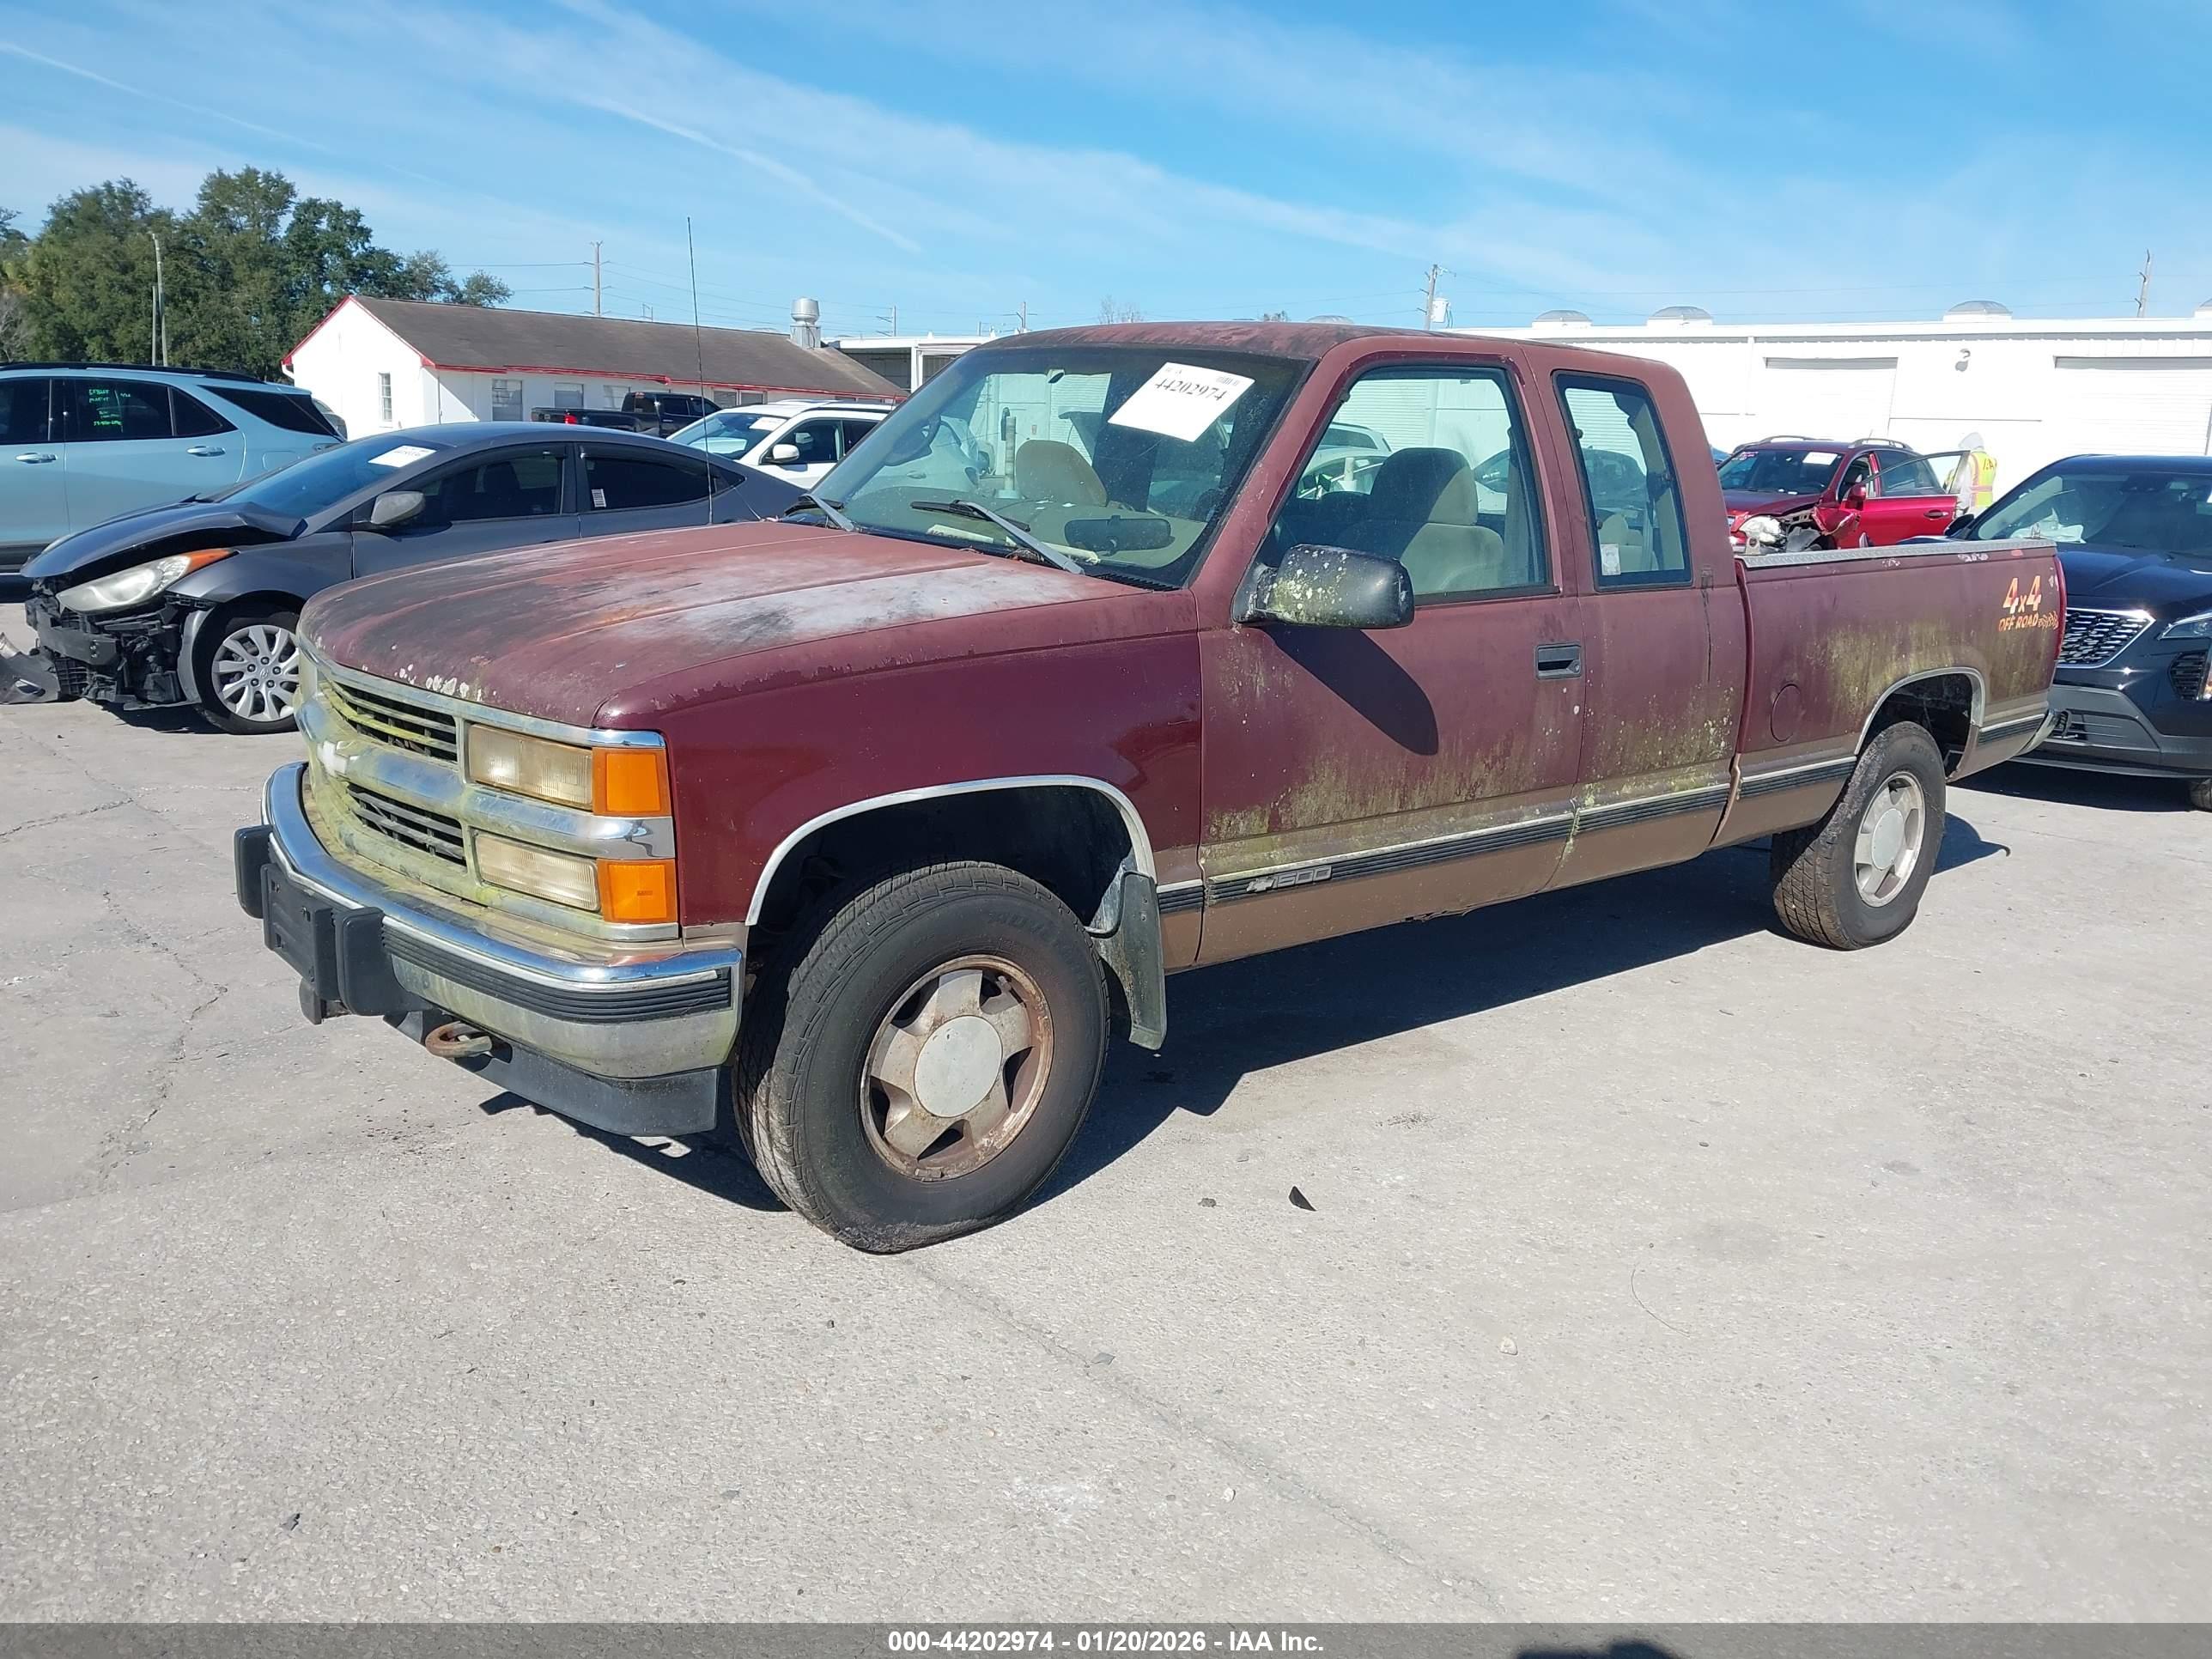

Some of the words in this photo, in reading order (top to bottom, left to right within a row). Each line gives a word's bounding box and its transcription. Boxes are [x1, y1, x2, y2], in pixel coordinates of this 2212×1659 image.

[1155, 378, 1228, 401] 44202974
[1998, 616, 2015, 632] OFF
[2015, 612, 2039, 629] ROAD
[1273, 865, 1332, 889] 1500
